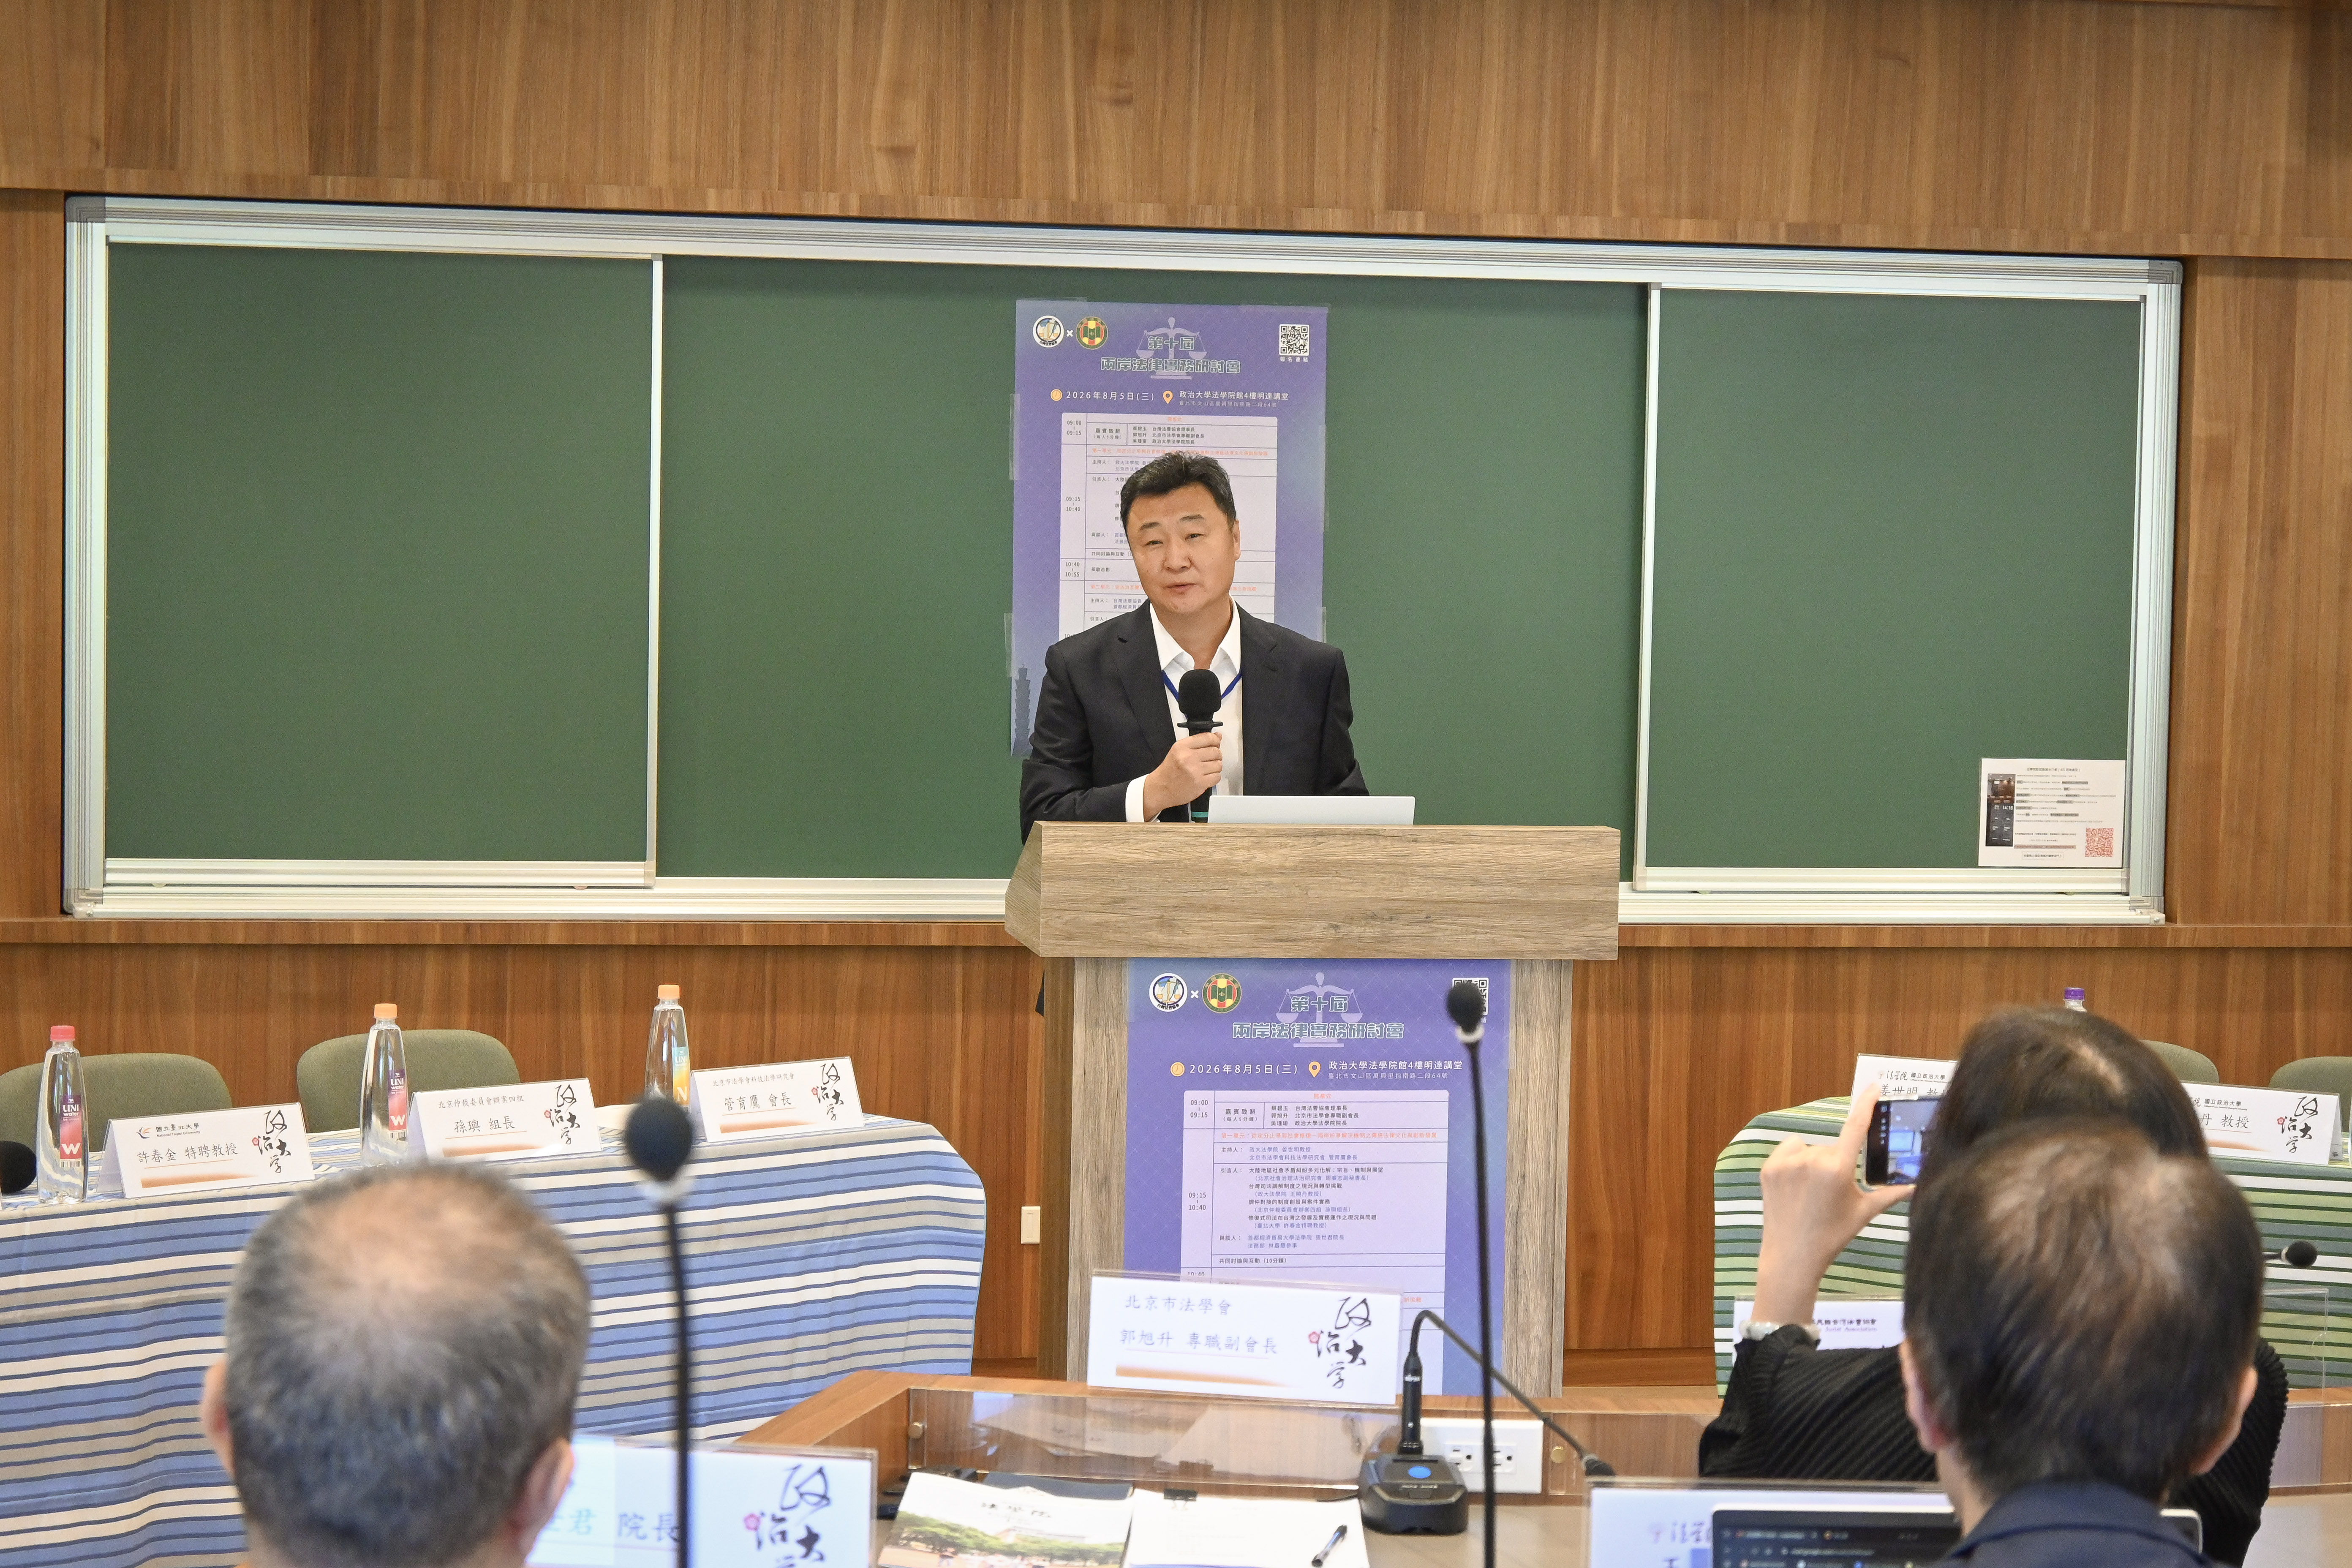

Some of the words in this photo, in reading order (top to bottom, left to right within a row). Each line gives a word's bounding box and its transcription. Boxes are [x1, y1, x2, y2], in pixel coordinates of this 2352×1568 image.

[1290, 996, 1349, 1012] 第十屆
[1232, 1022, 1405, 1039] 兩岸法律實務研討會
[1190, 1064, 1297, 1075] 2026年8月5日(三)
[1329, 1060, 1462, 1070] 政治大學法學院館4樓明達講堂
[390, 1078, 404, 1086] UNI
[63, 1104, 79, 1113] UNI
[724, 1094, 760, 1113] 管育鷹
[769, 1092, 792, 1109] 會長
[2204, 1098, 2241, 1107] 國立政治大學
[390, 1114, 406, 1126] W
[489, 1116, 515, 1130] 組長
[2221, 1114, 2249, 1129] 教授
[156, 1122, 200, 1134] 國立臺北大學
[61, 1143, 81, 1155] W
[136, 1148, 177, 1166] 許春金
[185, 1142, 238, 1161] 特聘教授
[1125, 1295, 1231, 1315] 北京市法學會
[1119, 1329, 1173, 1348] 郭旭升
[1186, 1332, 1278, 1354] 專職副會長
